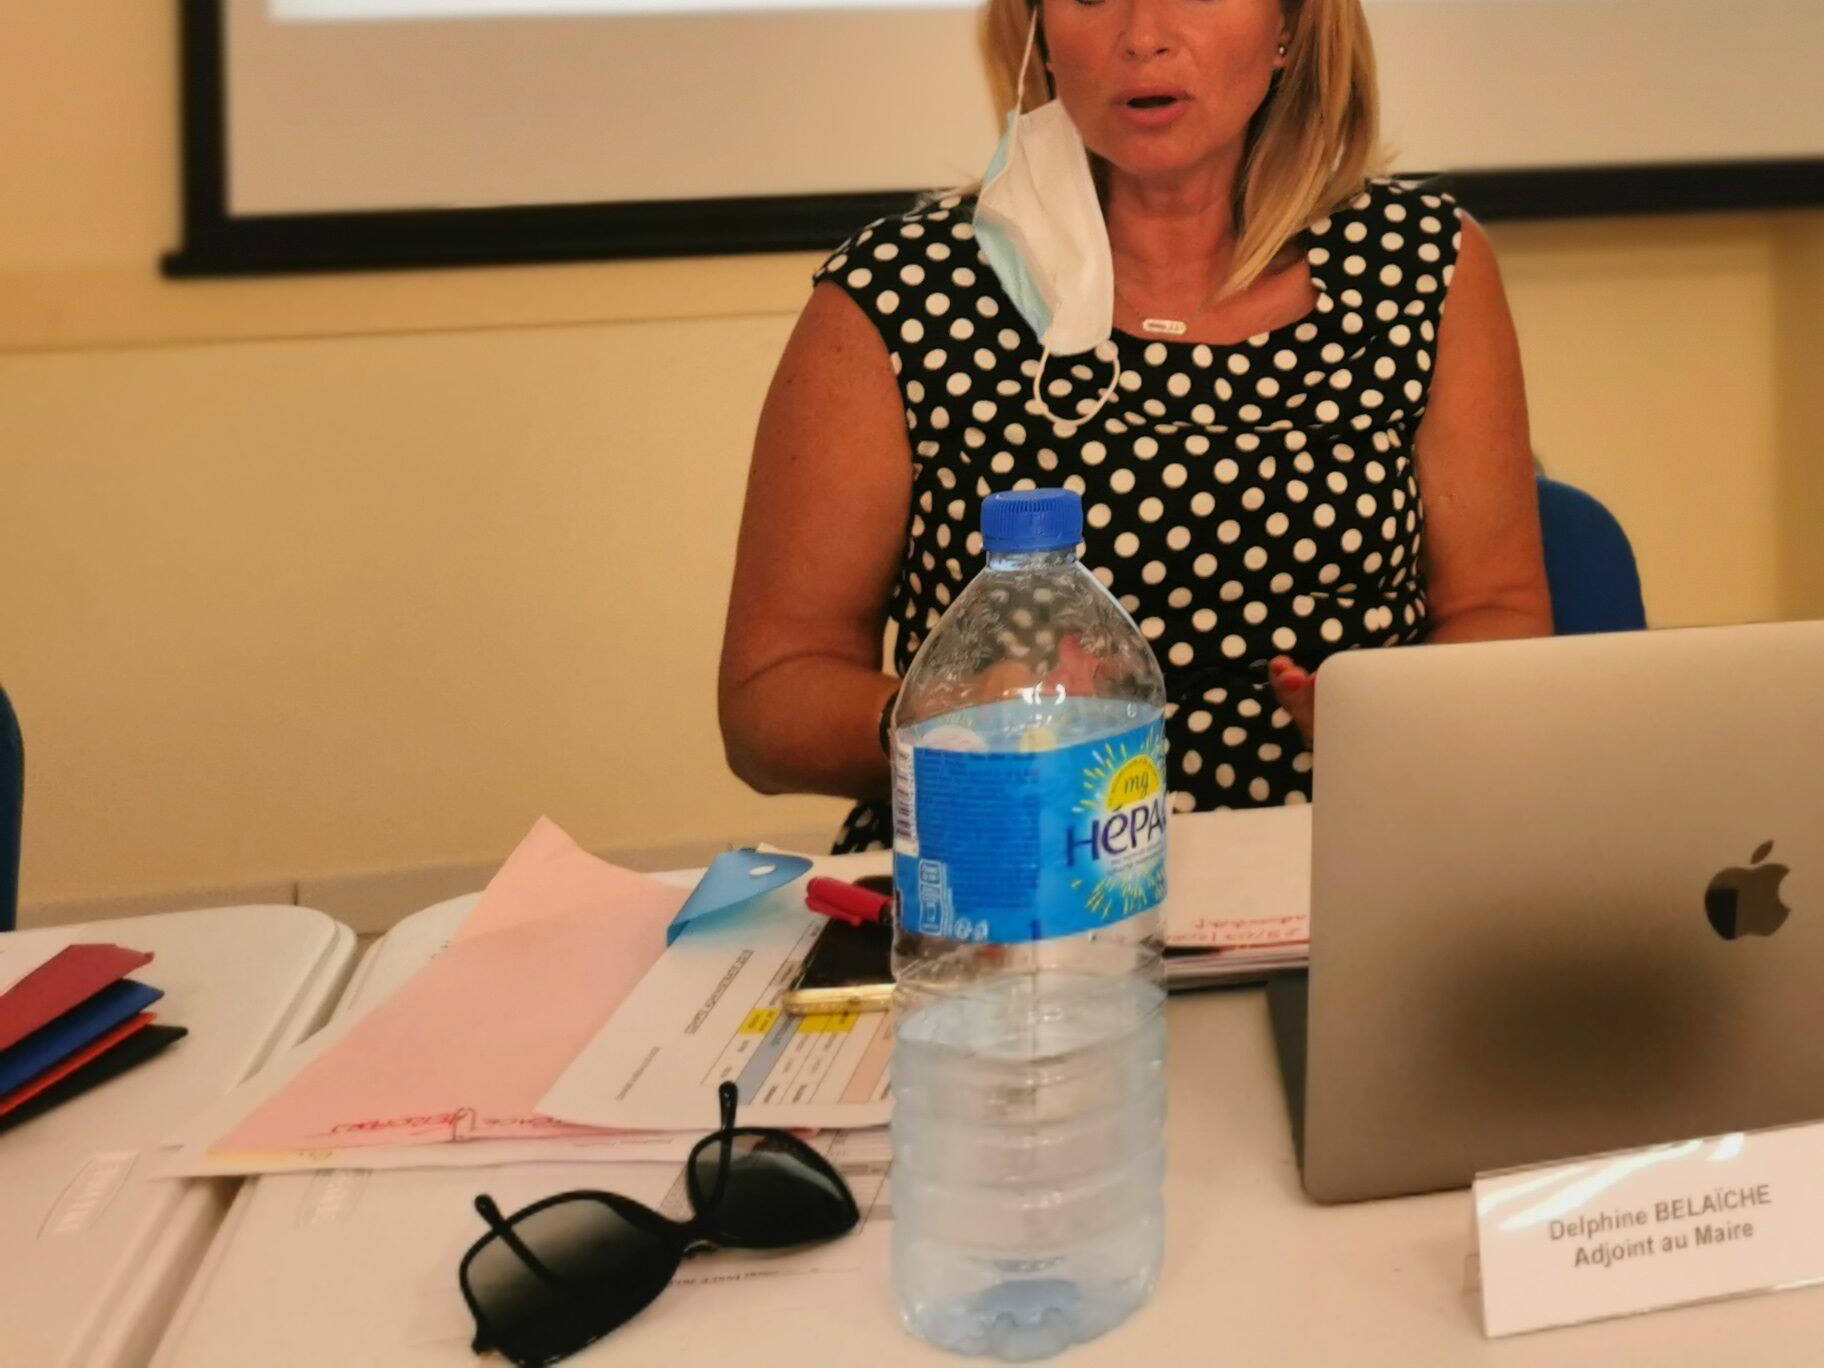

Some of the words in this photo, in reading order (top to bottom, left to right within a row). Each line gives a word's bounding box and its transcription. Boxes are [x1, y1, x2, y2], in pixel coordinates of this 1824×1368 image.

[1548, 1208, 1648, 1242] Delphine
[1655, 1183, 1773, 1224] BELAÏCHE
[1573, 1235, 1655, 1270] Adjoint
[1661, 1231, 1688, 1253] au
[1695, 1219, 1755, 1248] Maire
